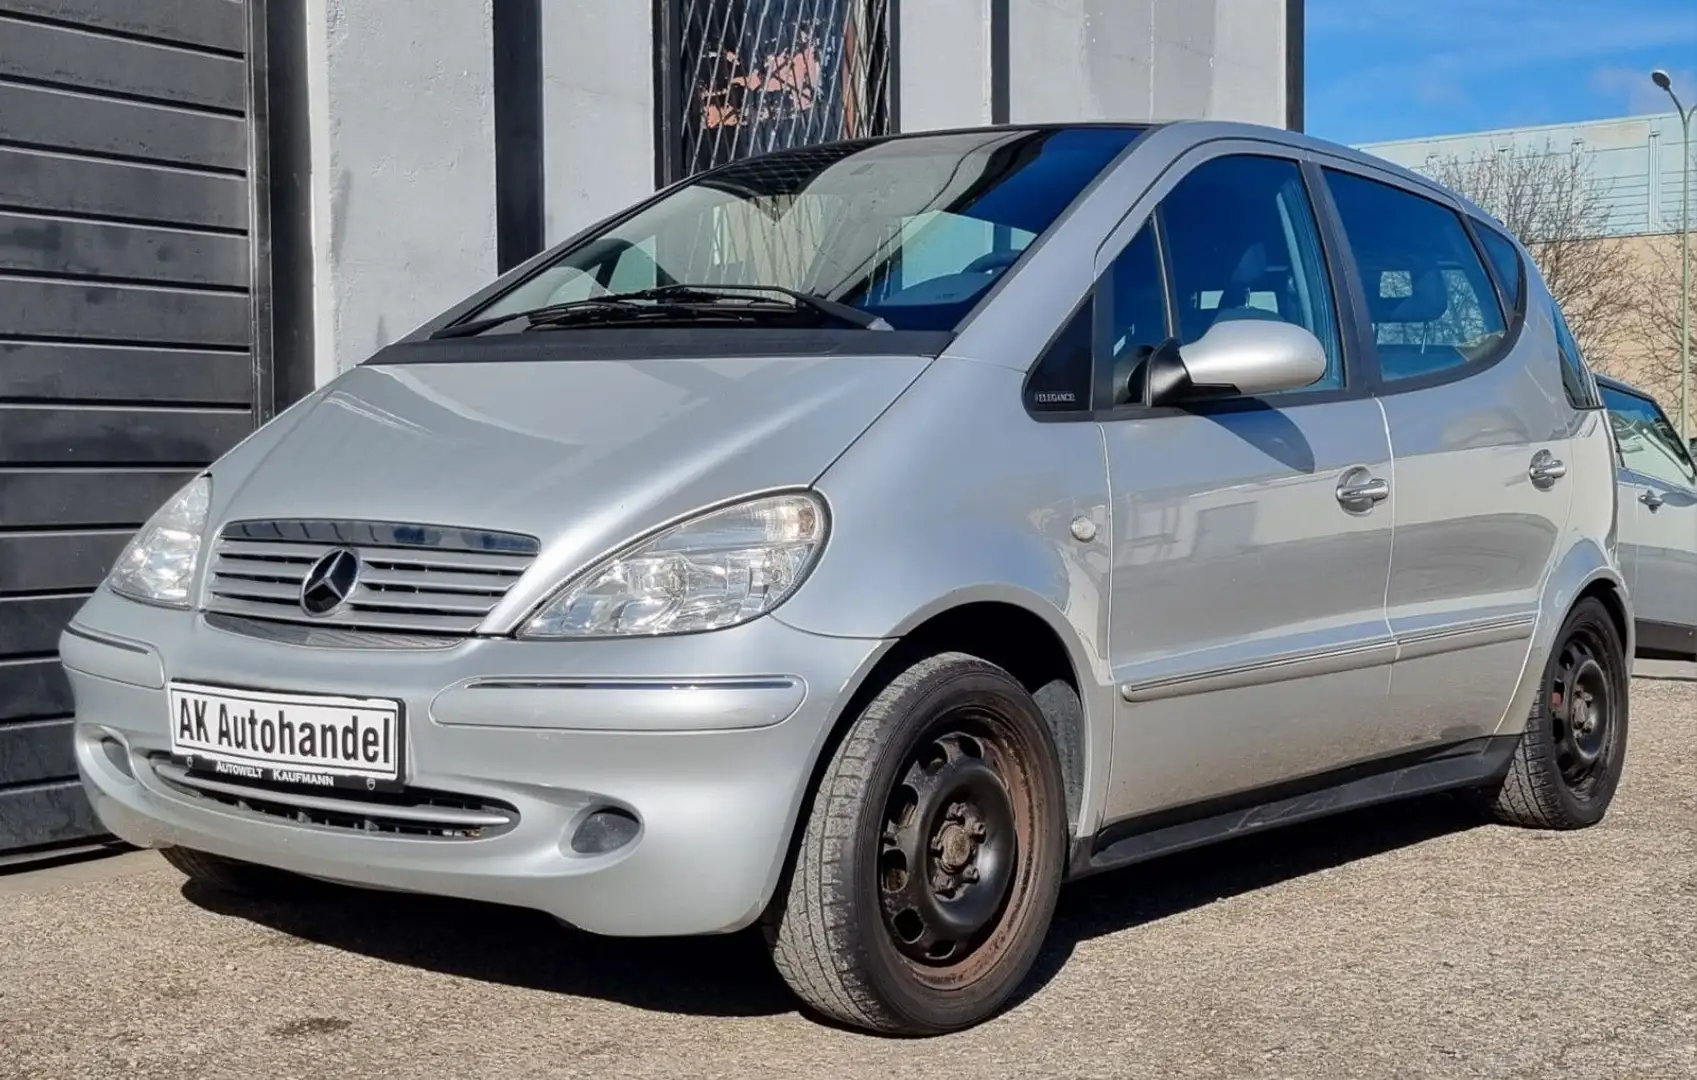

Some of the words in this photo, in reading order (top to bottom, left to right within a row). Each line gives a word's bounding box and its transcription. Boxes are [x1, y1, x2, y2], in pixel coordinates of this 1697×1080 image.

[1038, 393, 1076, 402] ELEGANCE
[180, 698, 209, 743] AK
[218, 703, 390, 764] Autohandel
[272, 769, 335, 787] KAUFMANN
